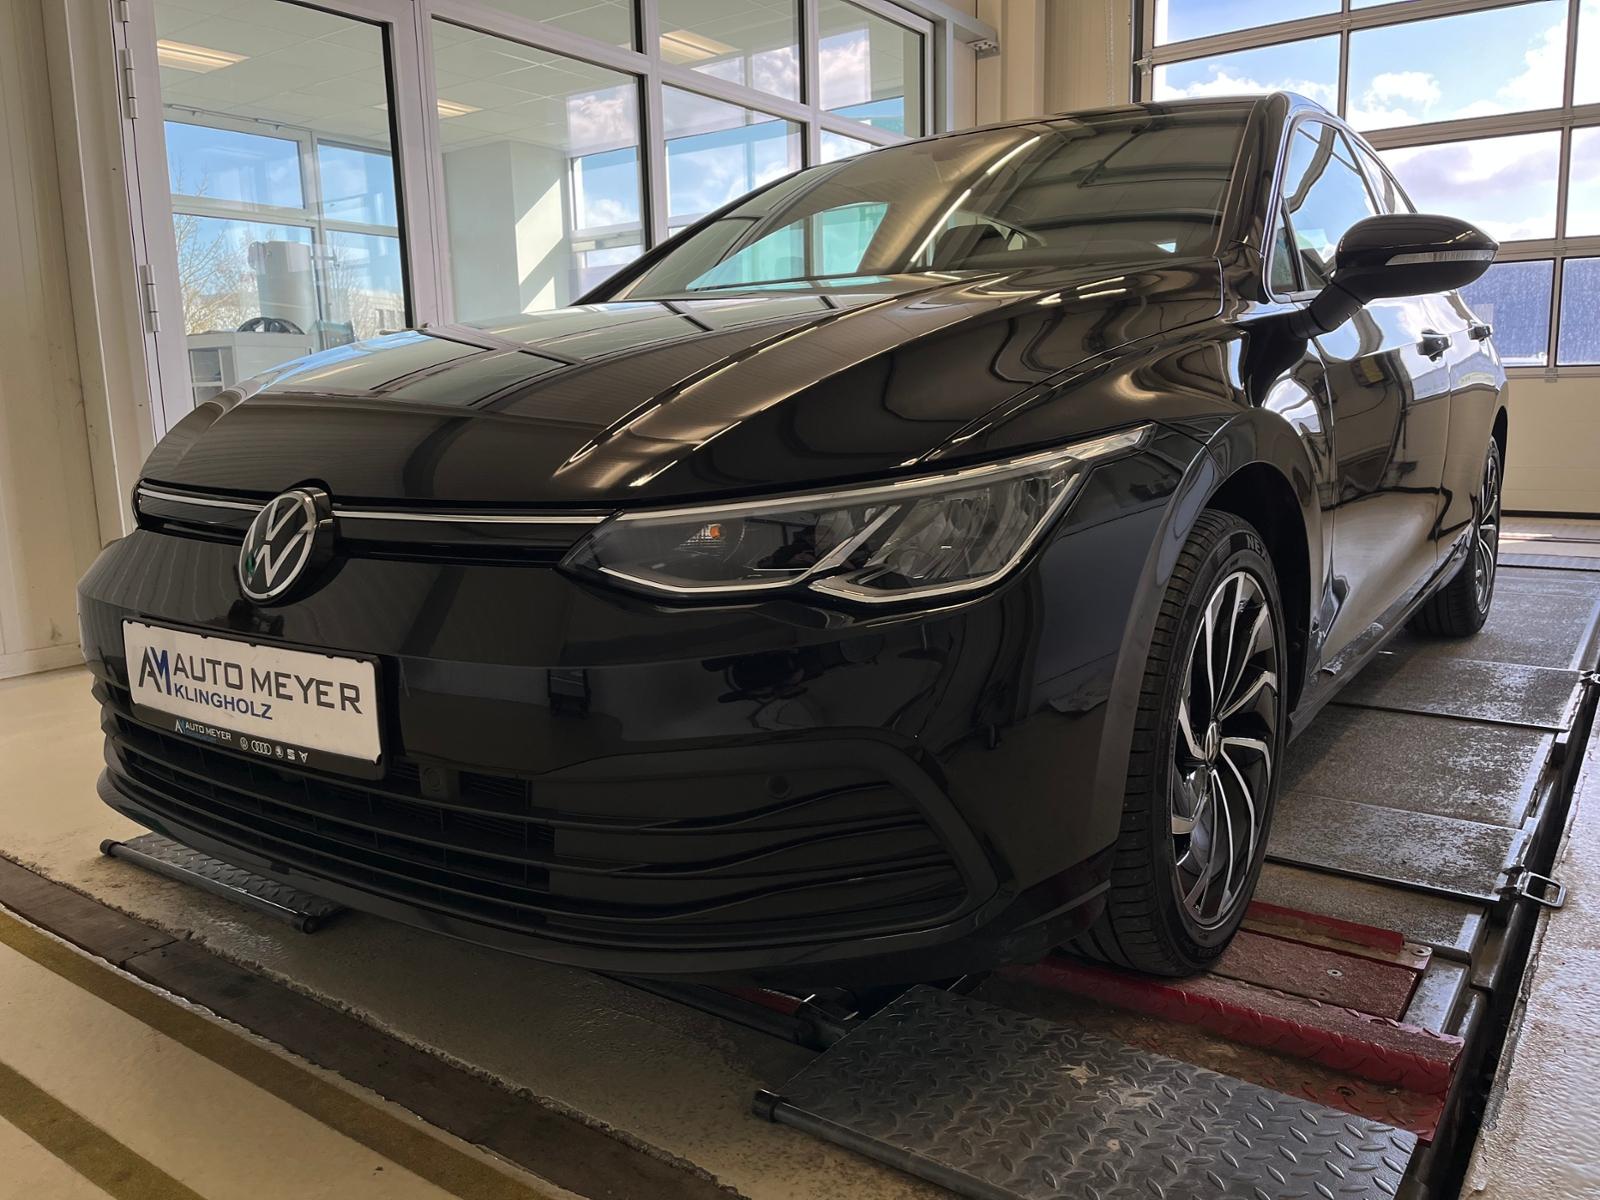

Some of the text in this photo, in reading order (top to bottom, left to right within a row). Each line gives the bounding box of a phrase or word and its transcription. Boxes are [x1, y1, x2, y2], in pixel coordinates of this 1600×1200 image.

[173, 653, 363, 714] AUTO MEYER
[174, 683, 273, 720] KLINGHOLZ
[185, 722, 205, 735] AUTO
[205, 728, 232, 741] MEYER
